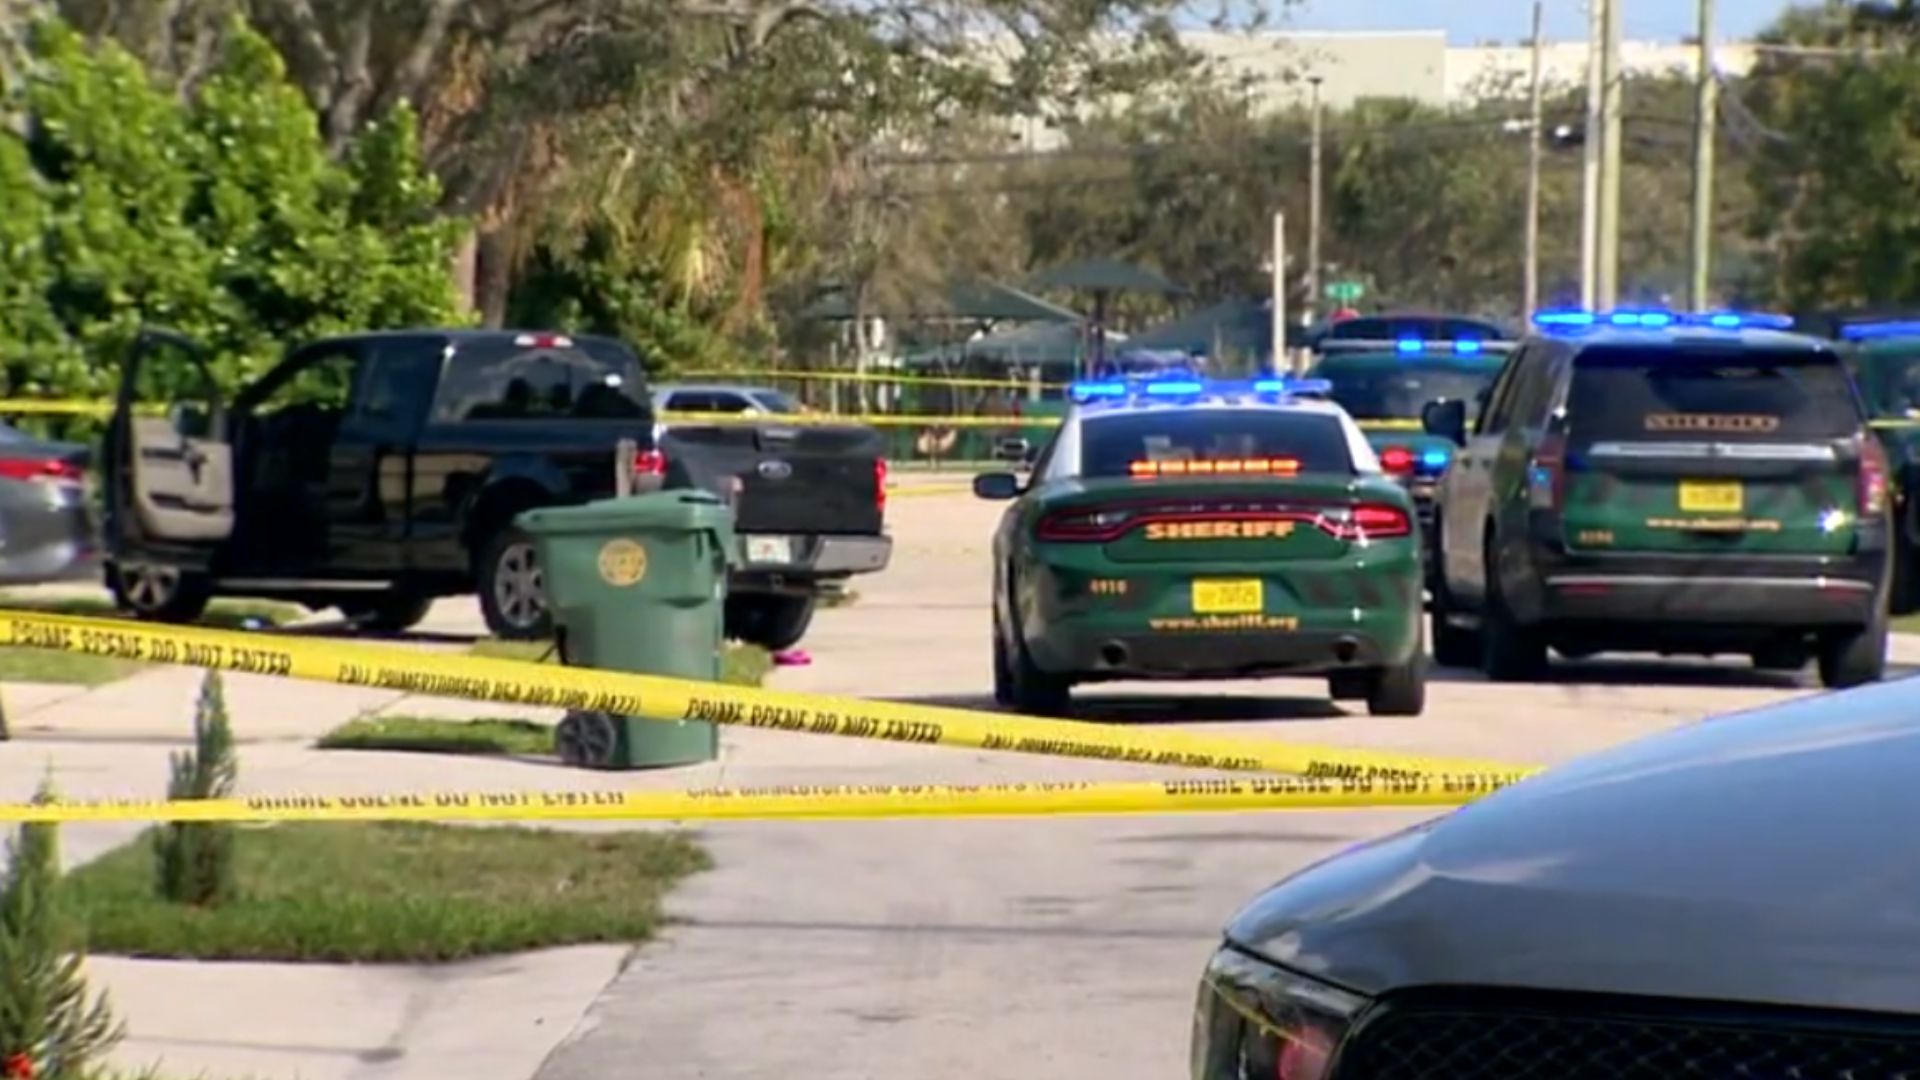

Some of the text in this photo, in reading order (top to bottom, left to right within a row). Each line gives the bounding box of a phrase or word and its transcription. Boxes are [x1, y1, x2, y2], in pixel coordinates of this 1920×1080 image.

[1145, 519, 1295, 540] SHERIFF
[1149, 614, 1298, 631] www.sheriff.org
[229, 648, 292, 677] ENTER
